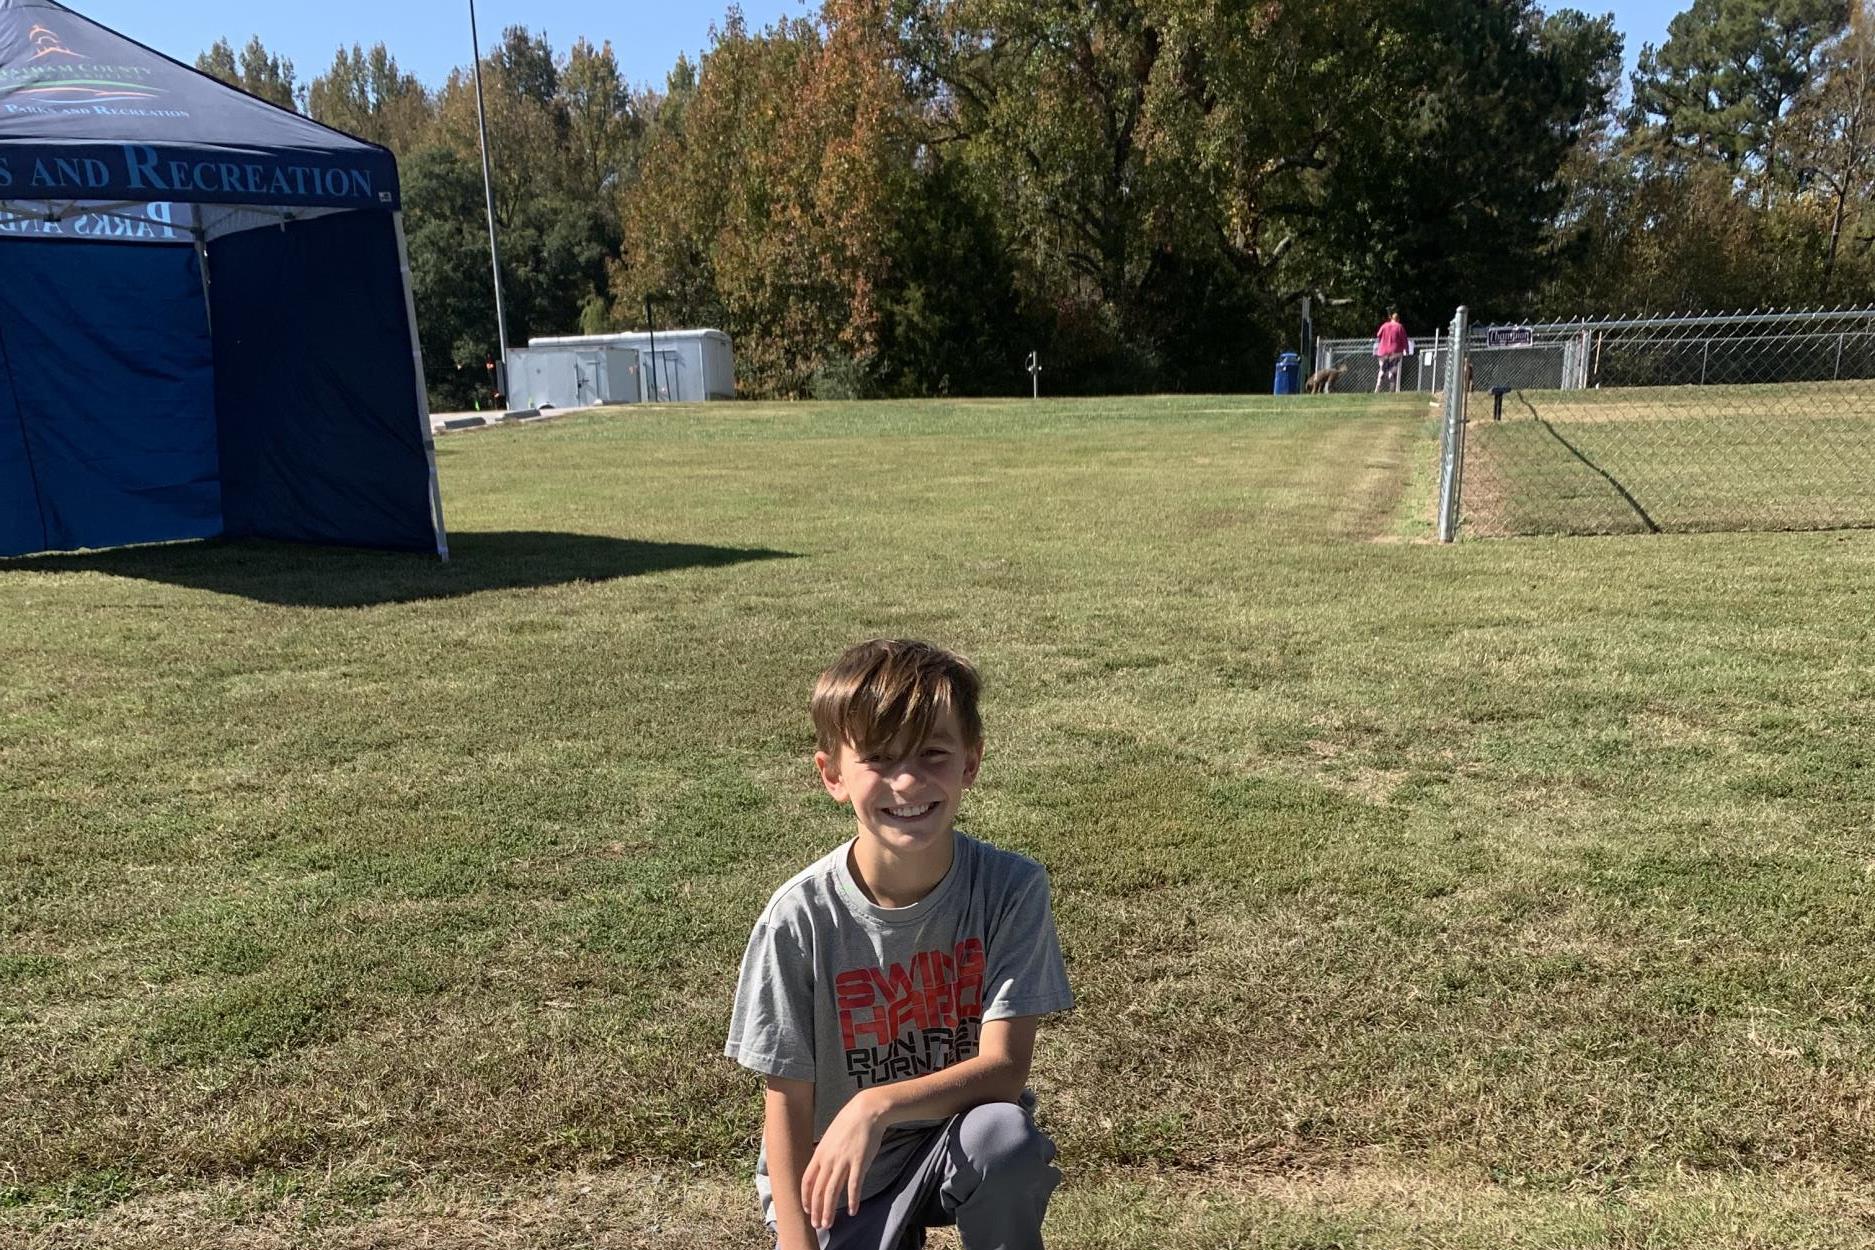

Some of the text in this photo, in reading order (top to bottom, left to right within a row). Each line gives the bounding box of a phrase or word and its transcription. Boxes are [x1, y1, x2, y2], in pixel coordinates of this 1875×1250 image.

[4, 103, 56, 114] PARKS
[91, 103, 191, 118] RECREATION
[32, 157, 111, 188] AND
[122, 144, 373, 197] RECREATION
[835, 937, 984, 1009] SWING
[839, 973, 984, 1050] HARD
[846, 1031, 917, 1071] RUN
[849, 1052, 931, 1088] TURN
